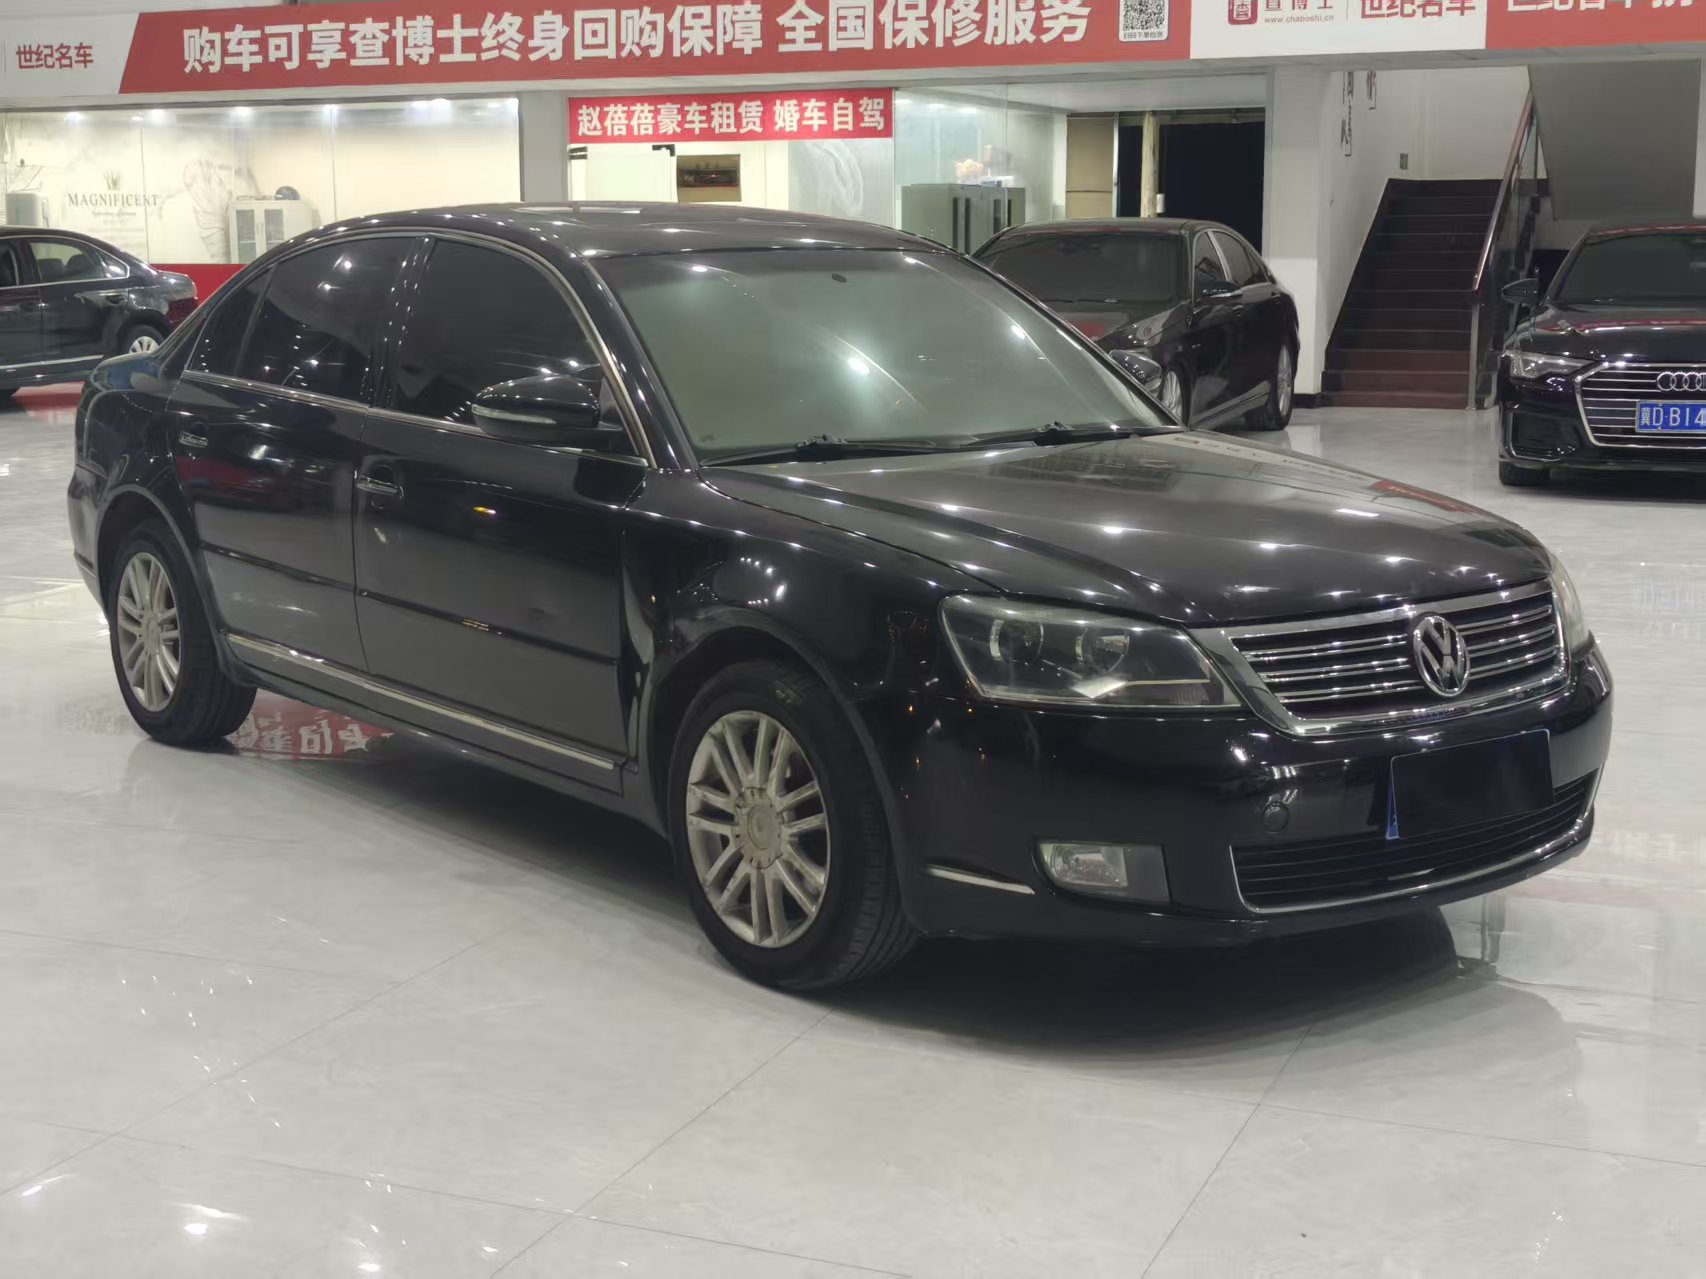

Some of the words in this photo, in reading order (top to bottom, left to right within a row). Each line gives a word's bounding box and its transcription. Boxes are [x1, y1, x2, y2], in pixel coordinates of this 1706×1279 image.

[1264, 14, 1334, 23] www.chaboshi.cn
[183, 0, 763, 73] 购车可享查博士终身回购保障
[776, 0, 1092, 52] 全国保修服务
[16, 42, 94, 69] 世纪名车
[578, 99, 764, 136] 赵蓓蓓豪车租赁
[774, 97, 885, 131] 婚车自驾
[68, 193, 159, 206] MAGNIFICENT
